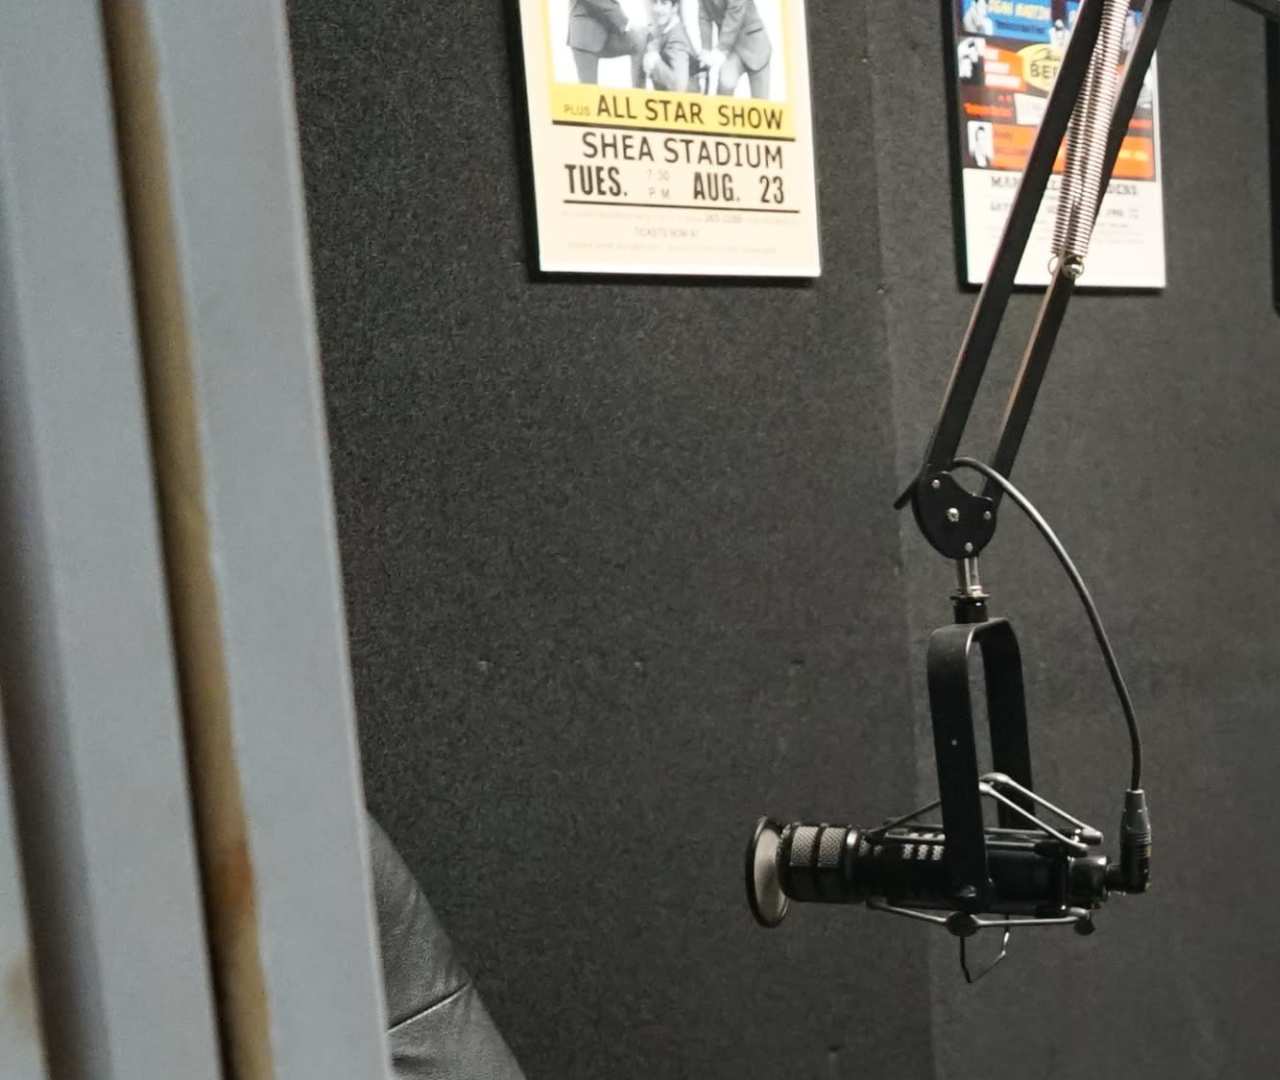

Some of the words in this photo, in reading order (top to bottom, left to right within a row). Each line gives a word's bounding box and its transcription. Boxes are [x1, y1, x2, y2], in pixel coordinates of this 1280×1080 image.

[597, 94, 637, 120] ALL
[645, 98, 704, 125] STAR
[718, 104, 784, 130] SHOW
[582, 131, 655, 161] SHEA
[664, 137, 784, 169] STADIUM
[564, 164, 629, 197] TUES.
[693, 171, 741, 203] AUG.
[759, 175, 785, 204] 23
